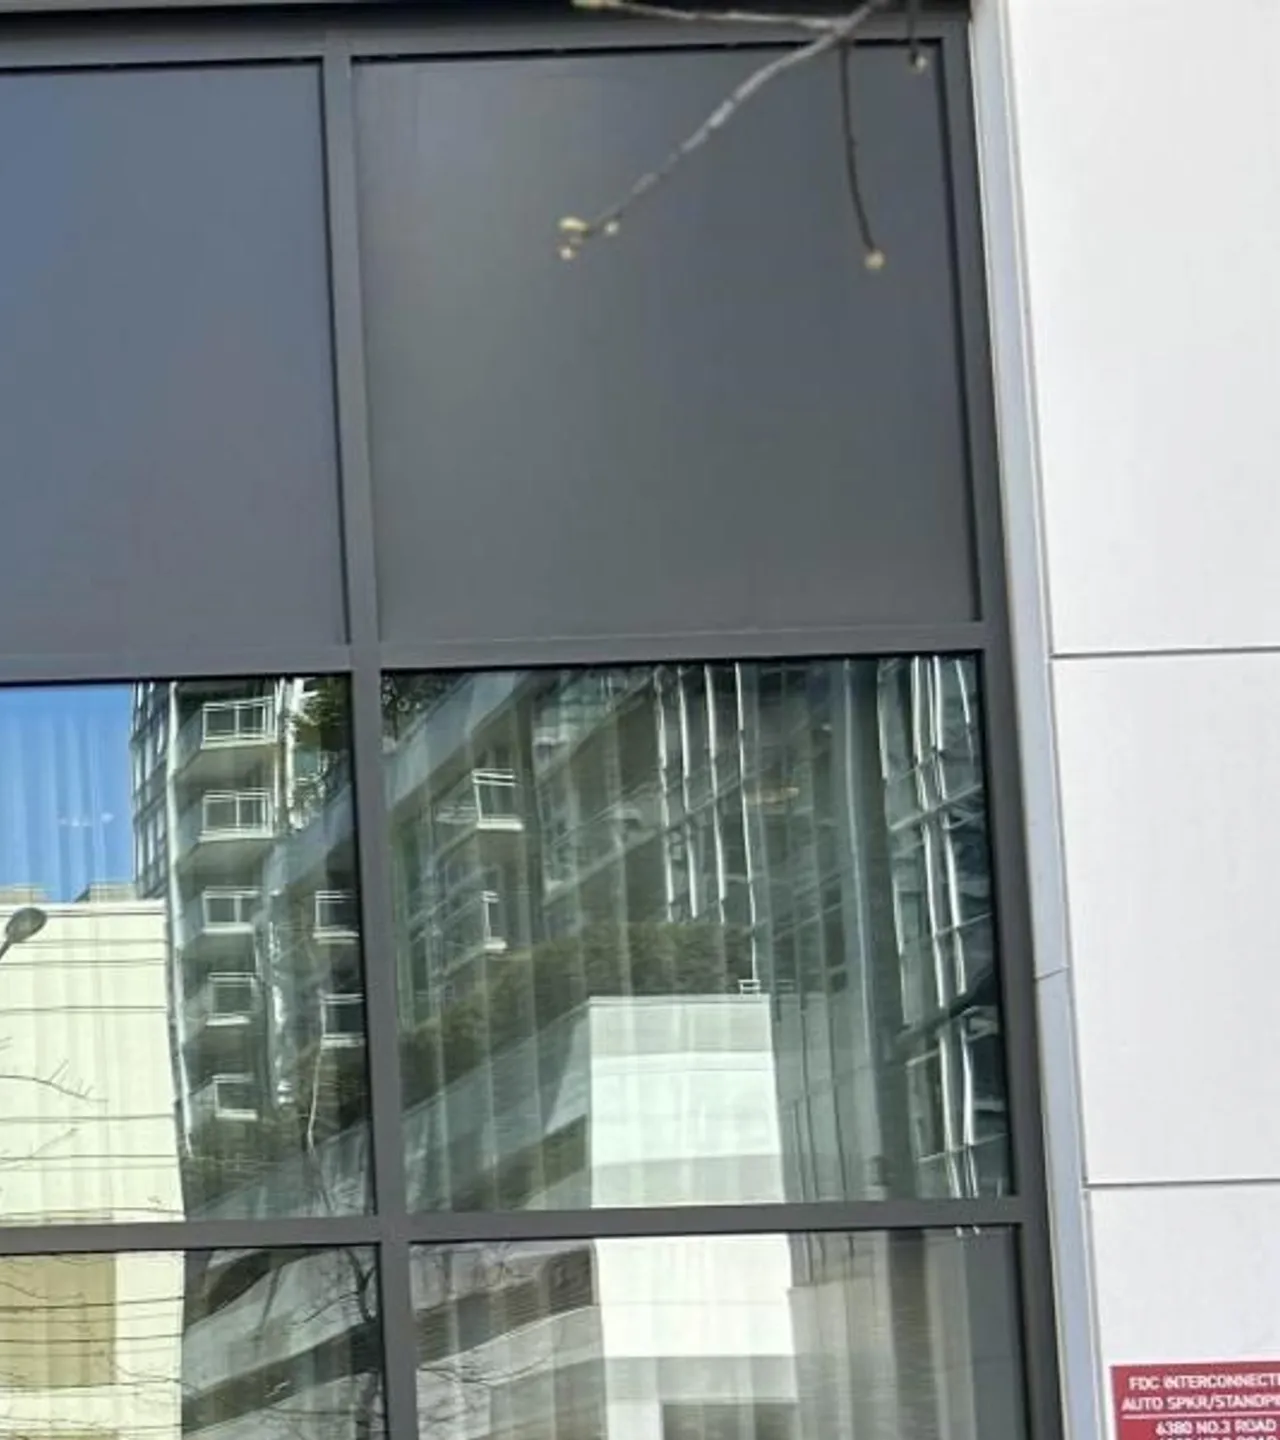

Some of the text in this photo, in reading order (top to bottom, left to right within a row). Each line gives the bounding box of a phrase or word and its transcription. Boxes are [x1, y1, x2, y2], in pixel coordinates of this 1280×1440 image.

[1128, 1372, 1280, 1391] FDC INTERCONNECT
[1121, 1396, 1164, 1411] AUTO
[1196, 1420, 1231, 1434] NO.3
[1234, 1418, 1277, 1433] ROAD
